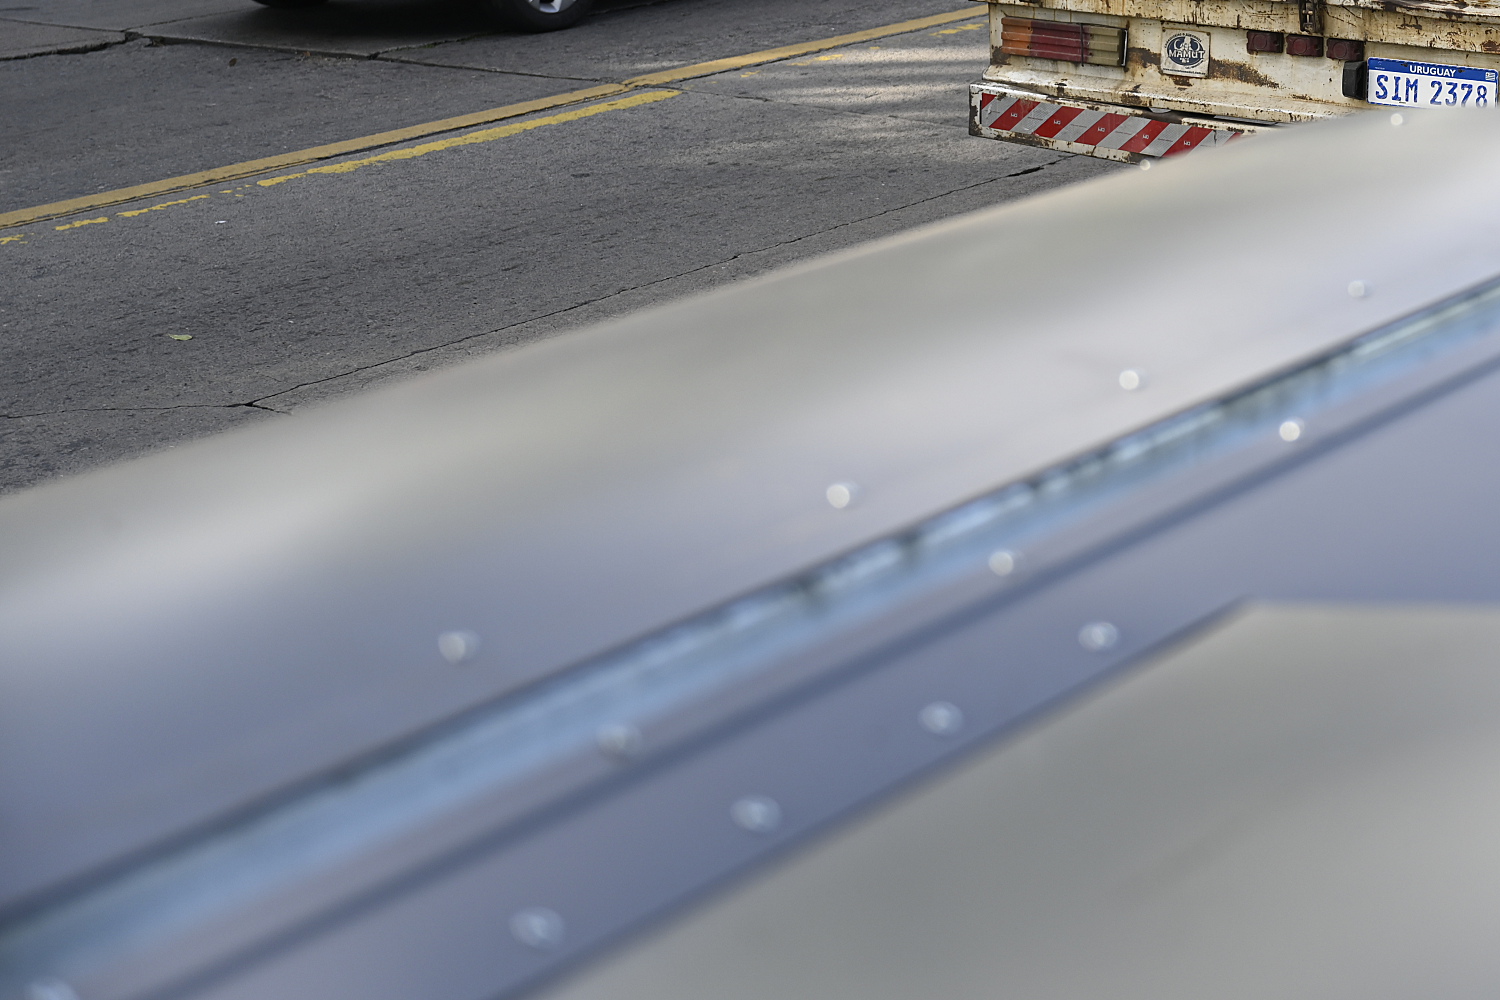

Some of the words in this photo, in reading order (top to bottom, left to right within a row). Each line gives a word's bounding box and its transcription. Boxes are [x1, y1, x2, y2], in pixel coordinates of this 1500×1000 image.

[1169, 49, 1205, 59] MAMUT
[1409, 65, 1457, 77] URUGUAY
[1375, 74, 1419, 103] SIM
[1430, 80, 1488, 109] 2378
